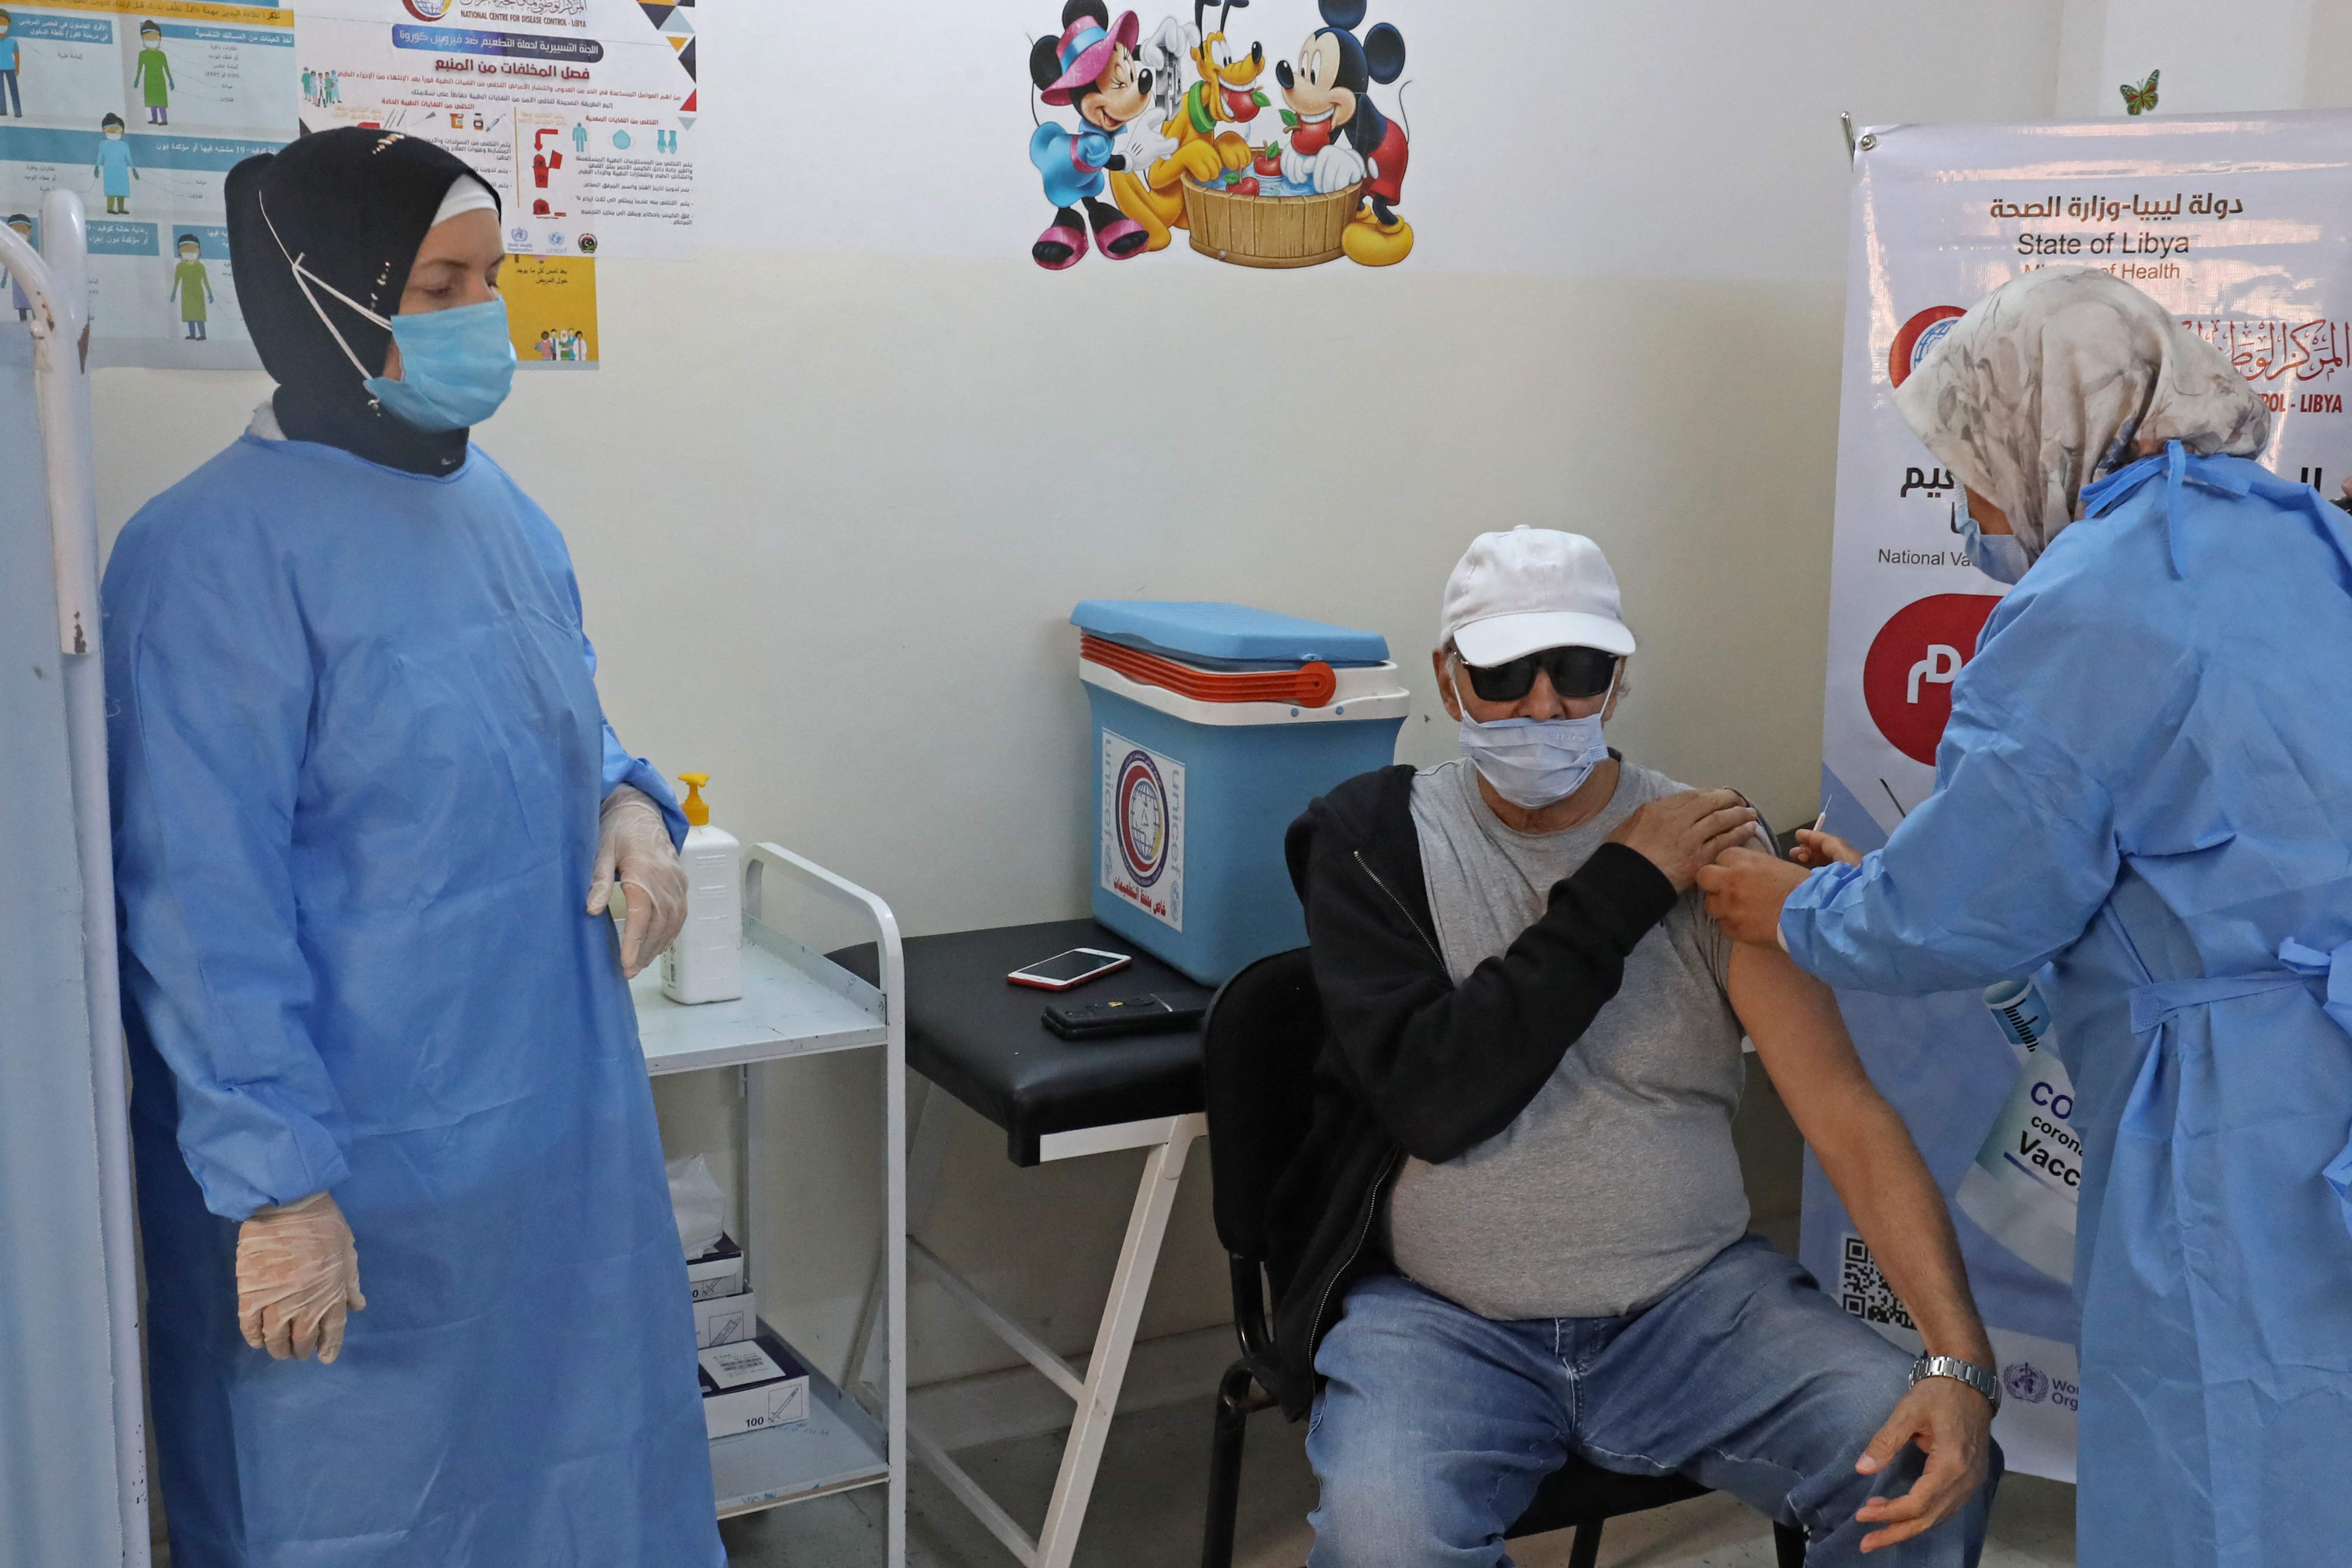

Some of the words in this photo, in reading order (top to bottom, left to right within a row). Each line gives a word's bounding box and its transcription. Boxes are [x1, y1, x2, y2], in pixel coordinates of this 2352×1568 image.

[202, 8, 219, 16] مهمة
[461, 10, 487, 20] NATIONAL
[489, 12, 508, 21] CENTRE
[510, 14, 520, 22] FOR
[521, 15, 542, 24] DISEASE
[544, 16, 567, 26] CONTROL
[572, 18, 586, 28] LIBYA
[195, 28, 220, 38] التنفسية
[260, 34, 279, 44] العينات
[282, 35, 293, 43] أخذ
[399, 29, 428, 43] كورونا
[430, 34, 462, 46] فيروس
[465, 36, 478, 45] ضد
[481, 37, 515, 49] التطعيم
[517, 39, 537, 49] لحملة
[540, 40, 577, 54] التسييرية
[579, 44, 598, 56] اللجنة
[435, 58, 474, 72] المنبع
[478, 61, 496, 74] من
[501, 62, 556, 78] المخلفات
[560, 66, 590, 80] فصل
[1990, 196, 2061, 218] الصحة
[2067, 193, 2182, 223] ليبيا-وزارة
[2188, 193, 2244, 220] دولة
[2017, 233, 2081, 255] State
[2090, 232, 2114, 254] of
[2122, 231, 2190, 259] Libya
[2121, 263, 2180, 279] Health
[535, 277, 554, 285] المريض
[2300, 394, 2343, 413] LIBYA
[1878, 548, 1945, 566] National
[1951, 551, 1970, 567] Va
[1104, 738, 1114, 844] unicef
[1170, 769, 1182, 879] unicef
[1113, 876, 1140, 902] التطعيمات
[1140, 888, 1152, 912] بحفظ
[1153, 899, 1166, 917] خاص
[2030, 1081, 2073, 1120] CO
[2020, 1130, 2081, 1187] Vacc
[2052, 1392, 2079, 1412] Org
[745, 1415, 764, 1428] 100
